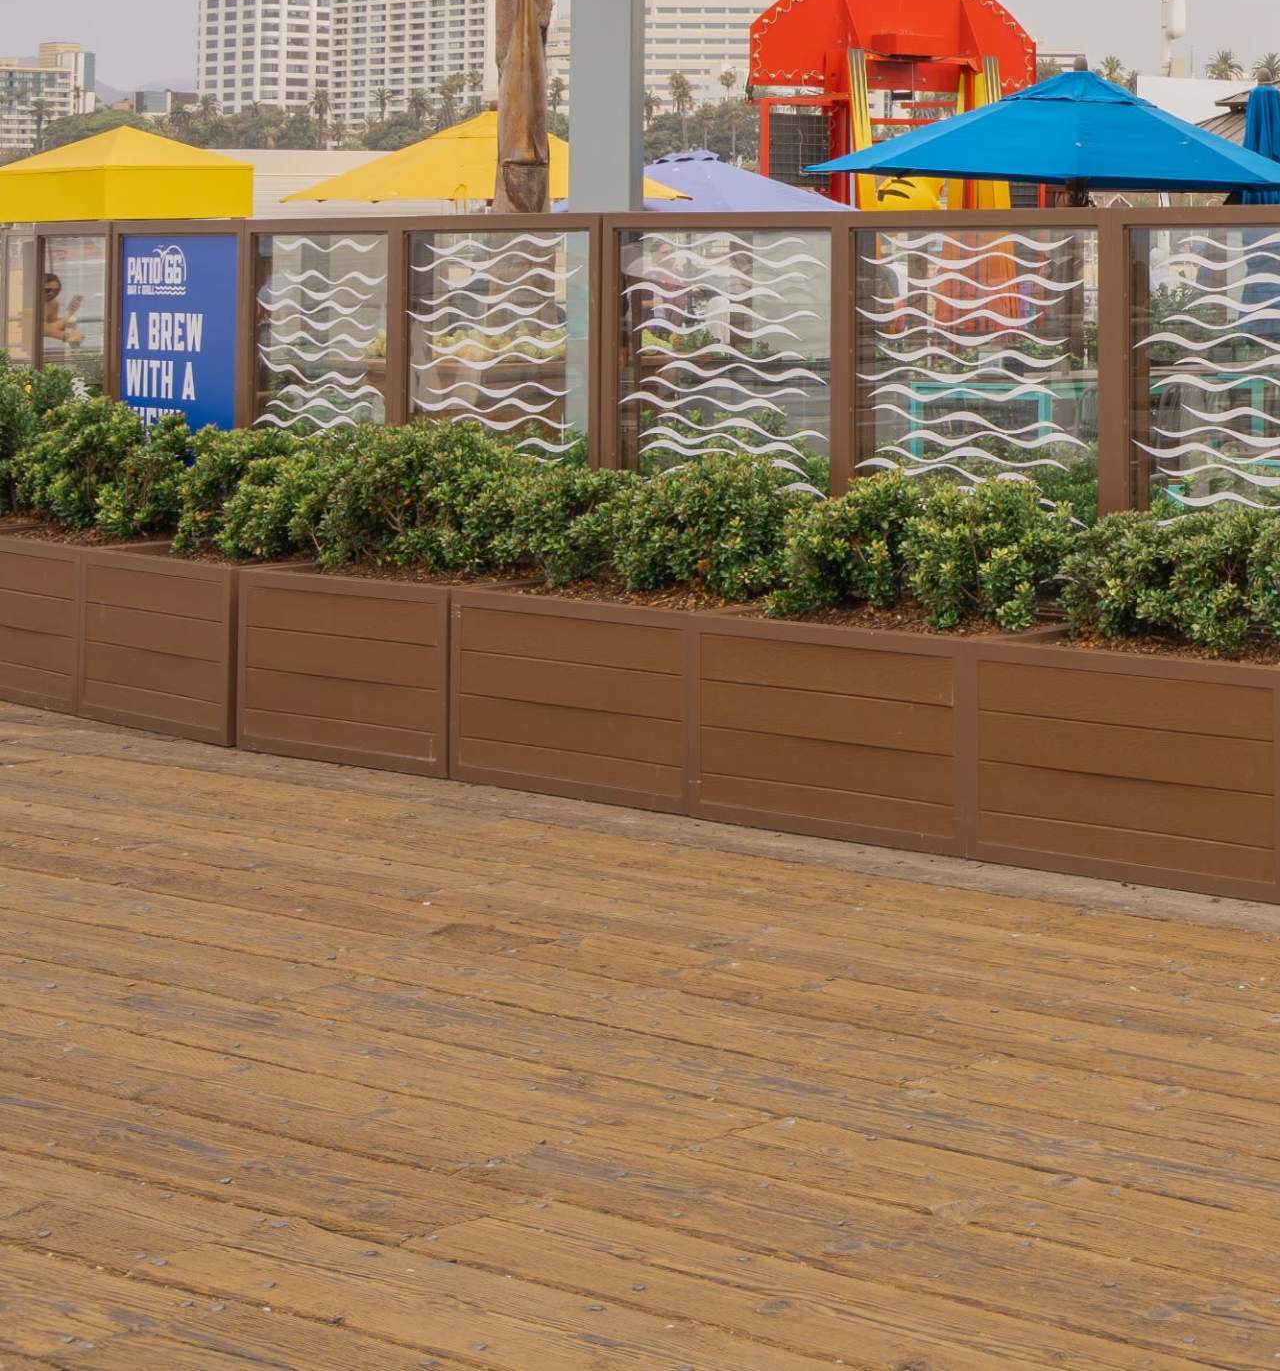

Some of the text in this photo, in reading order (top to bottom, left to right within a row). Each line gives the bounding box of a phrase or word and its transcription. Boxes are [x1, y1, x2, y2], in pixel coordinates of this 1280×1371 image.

[127, 254, 182, 284] PATIO 66
[126, 312, 203, 352] A BREW
[126, 359, 196, 401] WITH A
